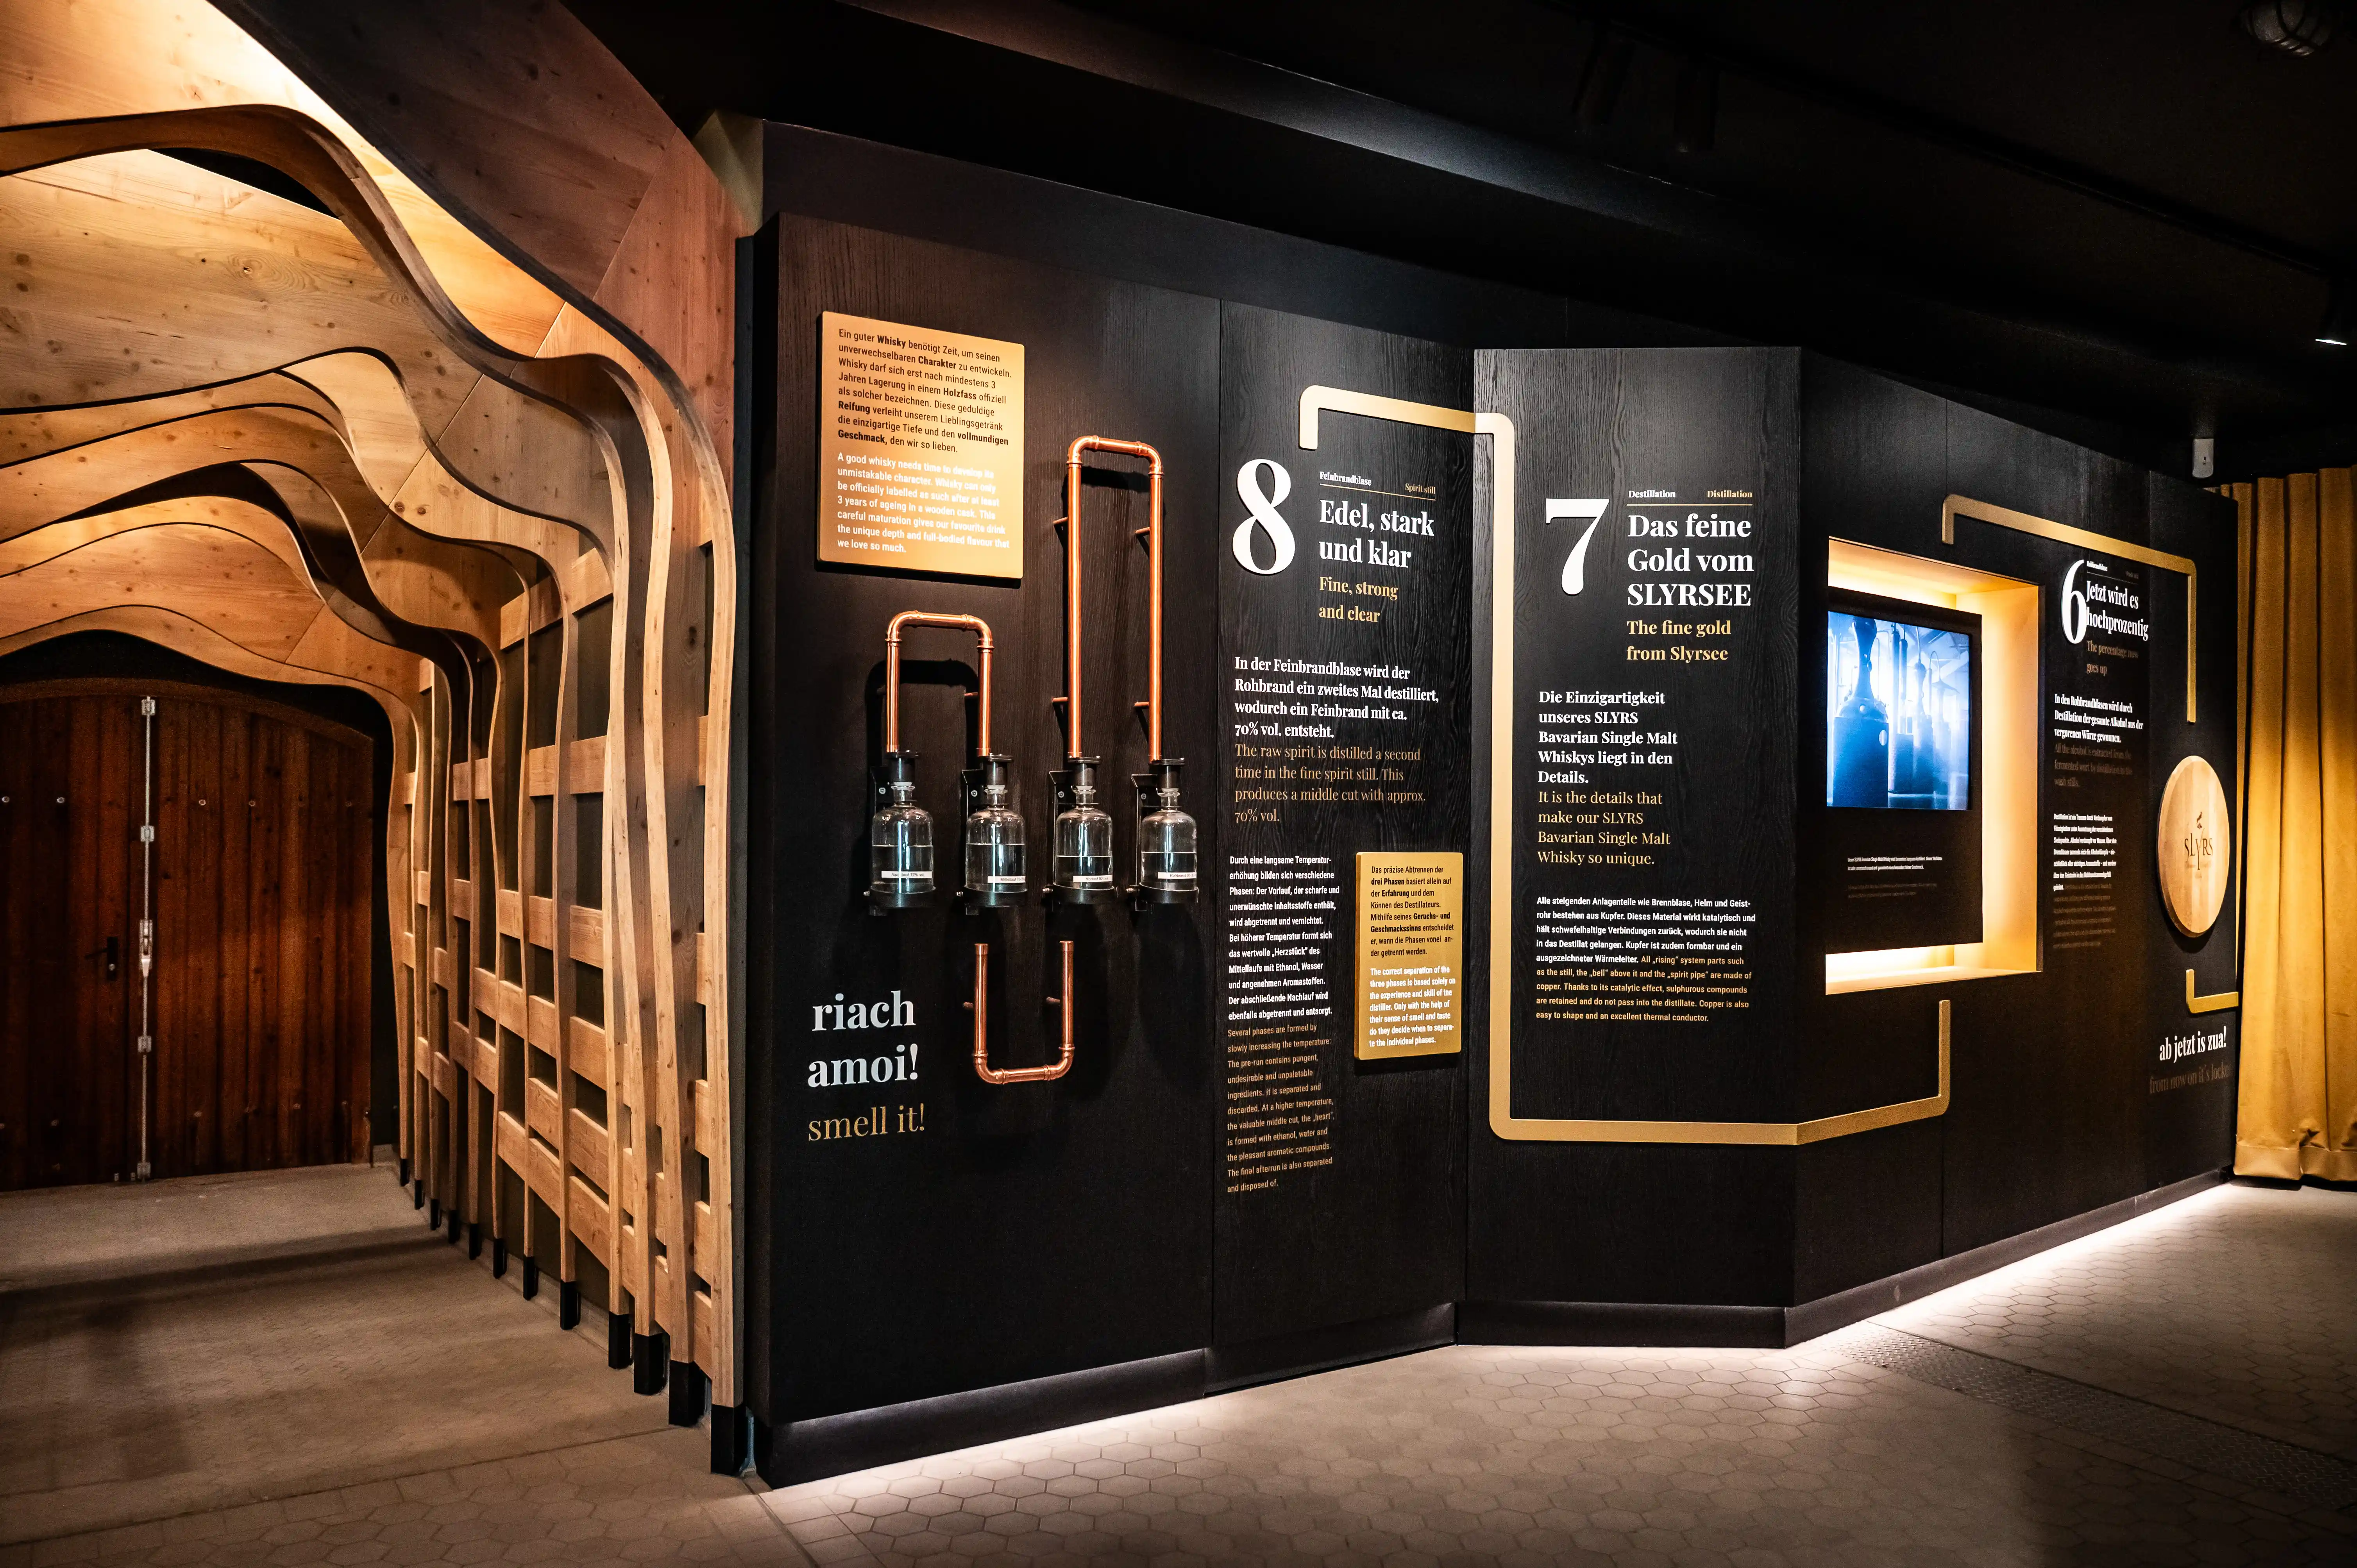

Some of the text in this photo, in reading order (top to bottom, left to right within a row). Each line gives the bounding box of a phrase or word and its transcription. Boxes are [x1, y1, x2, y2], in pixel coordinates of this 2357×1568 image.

[839, 329, 851, 338] Ein
[854, 333, 874, 342] guter
[877, 335, 906, 349] Whisky
[909, 340, 940, 354] benötigt
[943, 346, 959, 357] Zeit,
[976, 352, 1000, 362] seinen
[839, 345, 915, 363] unverwechselbaren
[918, 356, 956, 369] Charakter
[970, 366, 1011, 377] entwickeln.
[1320, 472, 1371, 486] Feinbrandblase
[1405, 483, 1423, 492] Spirit
[1233, 459, 1295, 574] 8
[1320, 500, 1434, 536] Edel, stark
[1628, 513, 1751, 537] Das feine
[851, 539, 868, 549] love
[882, 544, 906, 552] much.
[1319, 538, 1411, 568] und klar
[1546, 499, 1609, 594] 7
[1628, 548, 1754, 571] Gold vom
[1320, 576, 1398, 601] Fine, strong
[1628, 584, 1751, 606] SLYRSEE
[2086, 580, 2139, 609] Jetzt wird es
[2062, 559, 2087, 644] 6
[1319, 604, 1380, 622] and clear
[1627, 620, 1731, 637] The fine gold
[2087, 607, 2149, 641] hochprozentig
[1627, 646, 1728, 663] from Slyrsee
[2087, 640, 2098, 652] The
[1235, 657, 1410, 679] In der Feinbrandblase wird der
[1235, 678, 1438, 703] Rohbrand ein zweites Mal destilliert,
[1539, 691, 1665, 706] Die Einzigartigkeit
[1234, 700, 1407, 720] wodurch ein Feinbrand mit ca.
[1539, 712, 1638, 723] unseres SLYRS
[1235, 721, 1334, 738] 70% vol. entsteht.
[1539, 731, 1677, 746] Bavarian Single Malt
[1538, 751, 1672, 766] Whiskys liegt in den
[1538, 771, 1588, 783] Details.
[1264, 856, 1293, 865] langsame
[1295, 856, 1331, 865] Temperatur-
[1384, 866, 1404, 874] präzise
[1230, 871, 1259, 881] erhöhung
[1268, 886, 1292, 895] Vorlauf,
[1552, 897, 1590, 906] steigenden
[1592, 898, 1636, 906] Anlagenteile
[1652, 899, 1692, 907] Brennblase,
[1404, 967, 1432, 975] separation
[812, 990, 916, 1031] riach
[2160, 1026, 2227, 1063] ab jetzt is zua!
[808, 1044, 917, 1087] amoi!
[809, 1103, 924, 1141] smell it!
